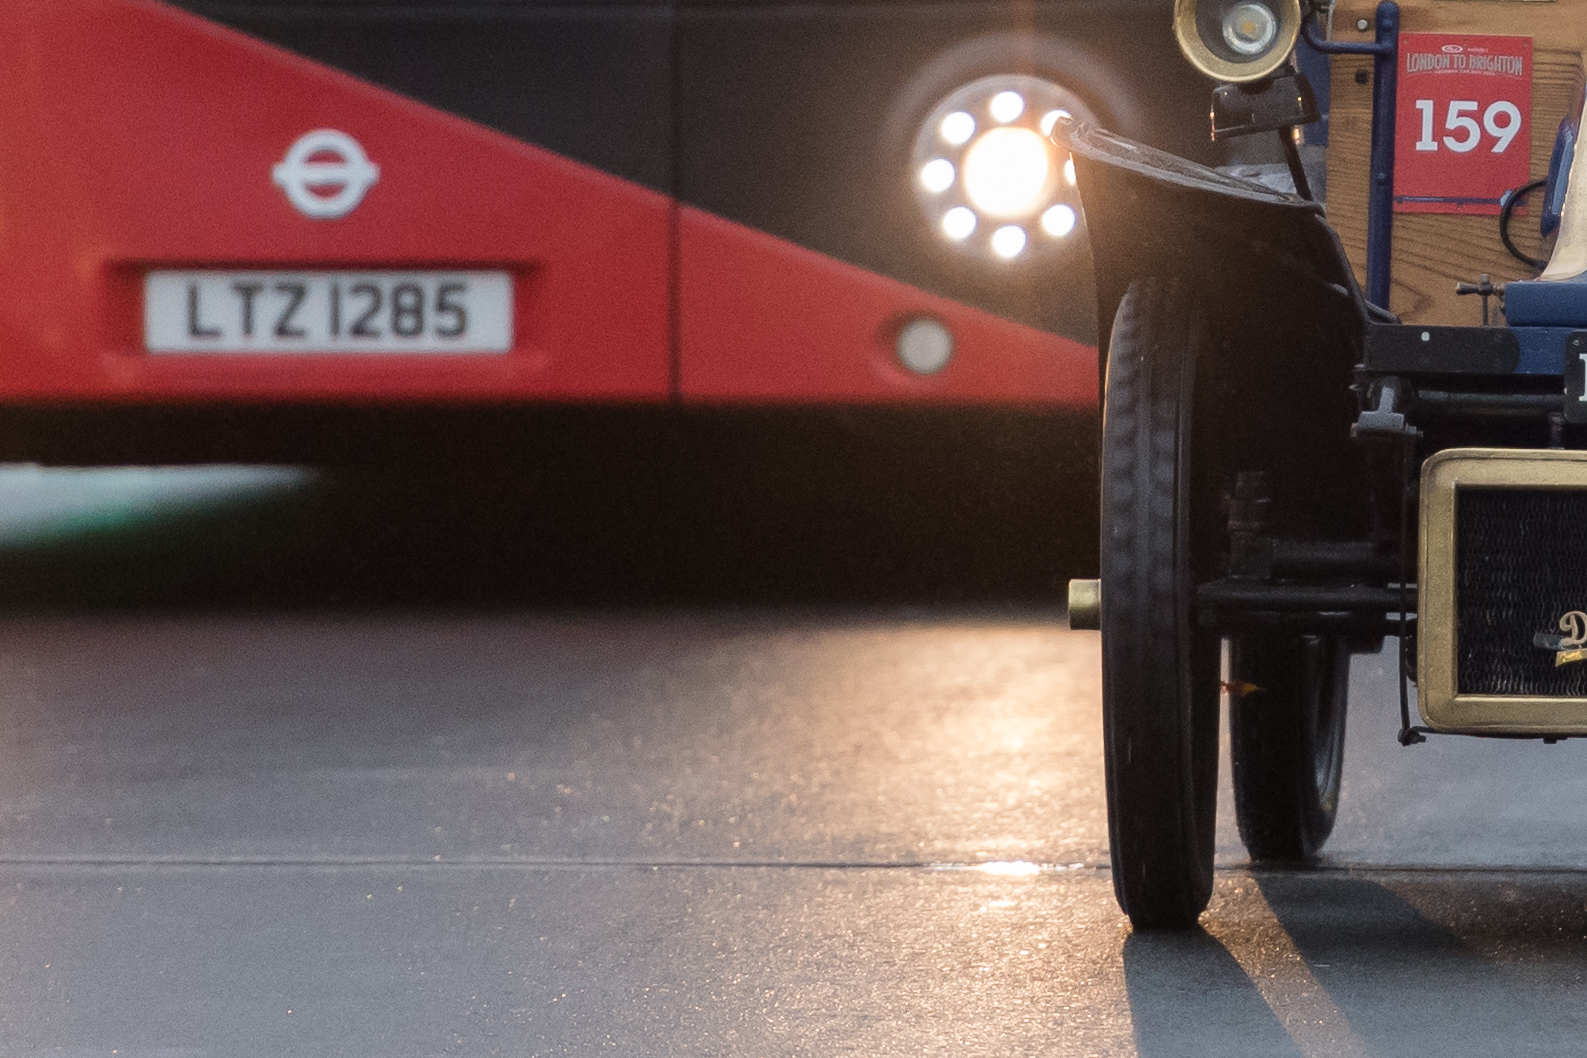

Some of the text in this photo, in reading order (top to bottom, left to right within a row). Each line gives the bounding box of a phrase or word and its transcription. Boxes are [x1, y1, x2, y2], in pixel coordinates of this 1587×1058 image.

[1406, 52, 1524, 77] LONDON TO BRIGHTON
[1415, 99, 1522, 153] 159
[185, 279, 470, 340] LTZ 1285
